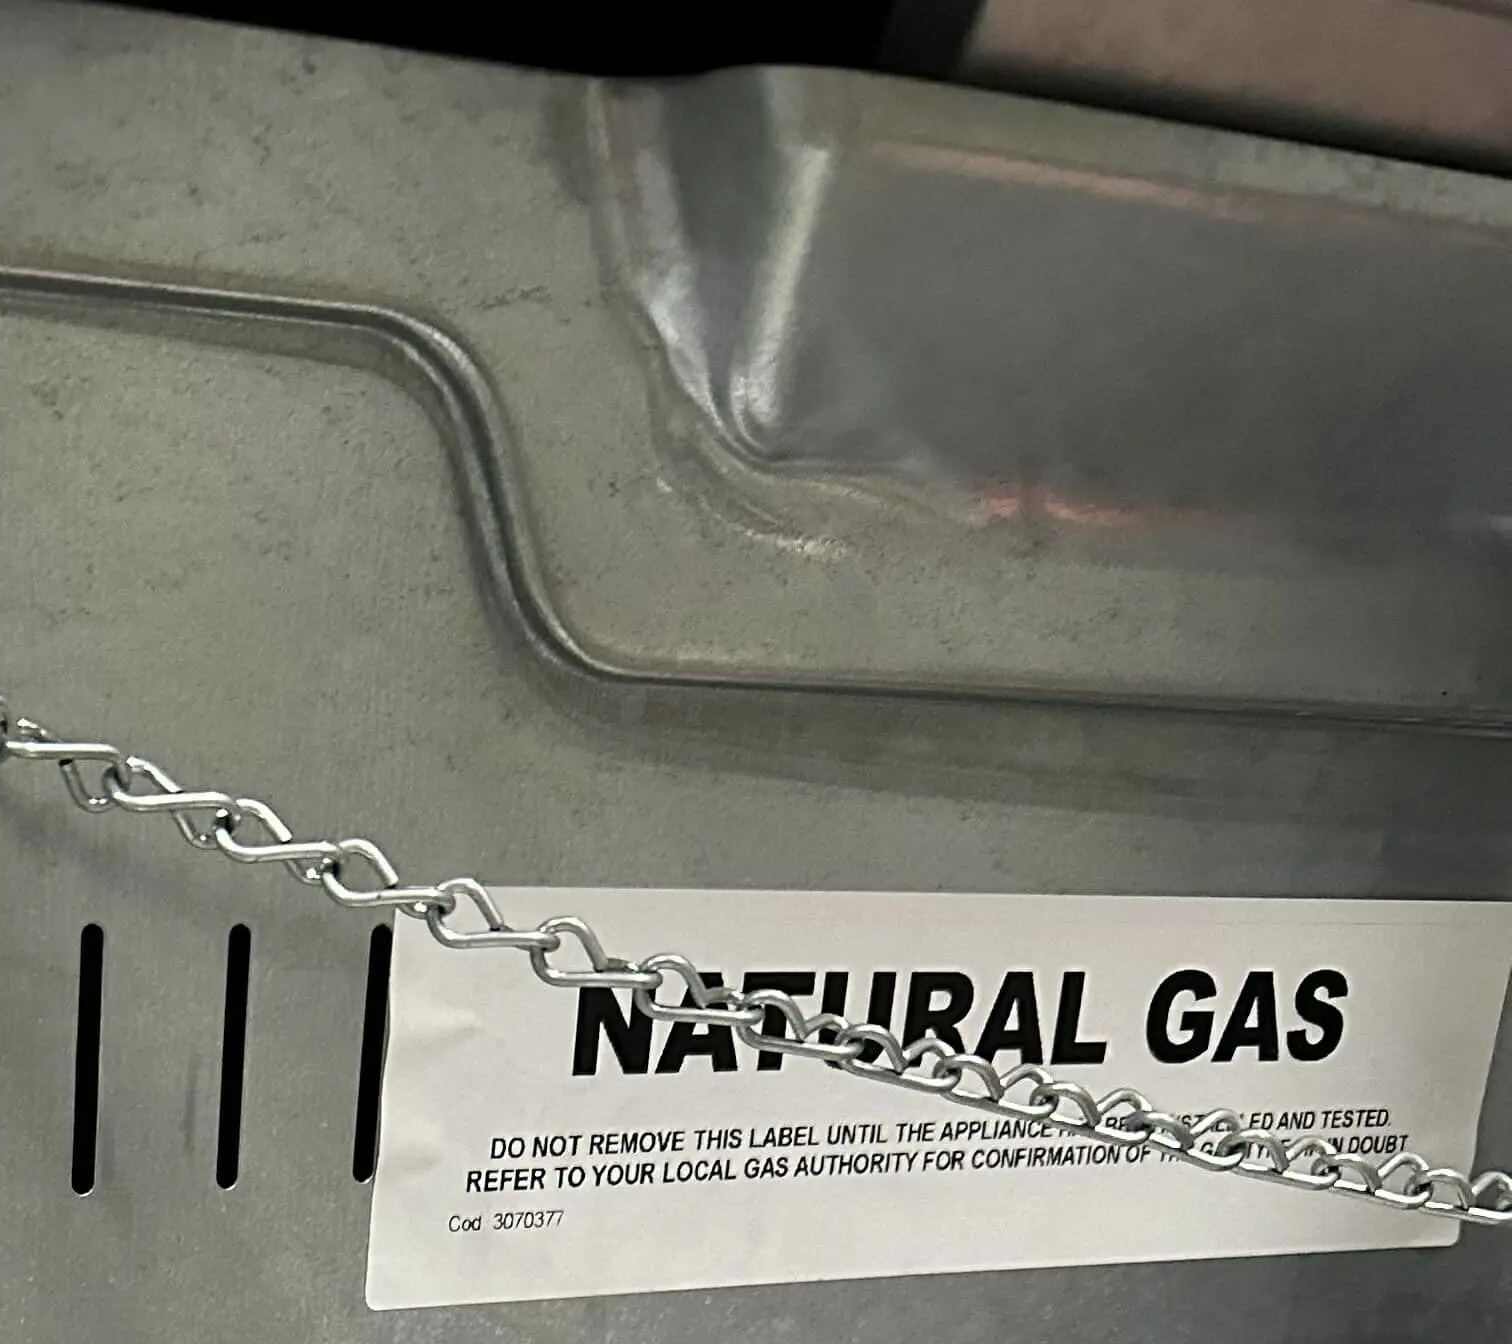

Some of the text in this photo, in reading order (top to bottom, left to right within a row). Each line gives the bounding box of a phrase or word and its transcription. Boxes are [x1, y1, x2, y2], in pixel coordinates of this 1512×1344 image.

[572, 967, 1350, 1076] NATURAL GAS
[490, 1136, 526, 1160] DO
[531, 1134, 583, 1159] NOT
[588, 1130, 686, 1156] REMOVE
[693, 1128, 743, 1151] THIS
[748, 1124, 821, 1149] LABEL
[826, 1122, 889, 1146] UNTIL
[895, 1121, 937, 1144] THE
[938, 1117, 1054, 1143] APPLIANCE
[1276, 1110, 1316, 1131] AND
[465, 1168, 547, 1194] REFER
[553, 1165, 586, 1190] TO
[590, 1162, 656, 1188] YOUR
[661, 1159, 738, 1184] LOCAL
[743, 1156, 790, 1179] GAS
[793, 1151, 918, 1178] AUTHORITY
[922, 1150, 965, 1172] FOR
[970, 1145, 1121, 1170] CONFIRMATION
[1125, 1144, 1152, 1164] OF
[1348, 1134, 1409, 1155] DOUBT
[448, 1208, 565, 1233] Cod 3070377
